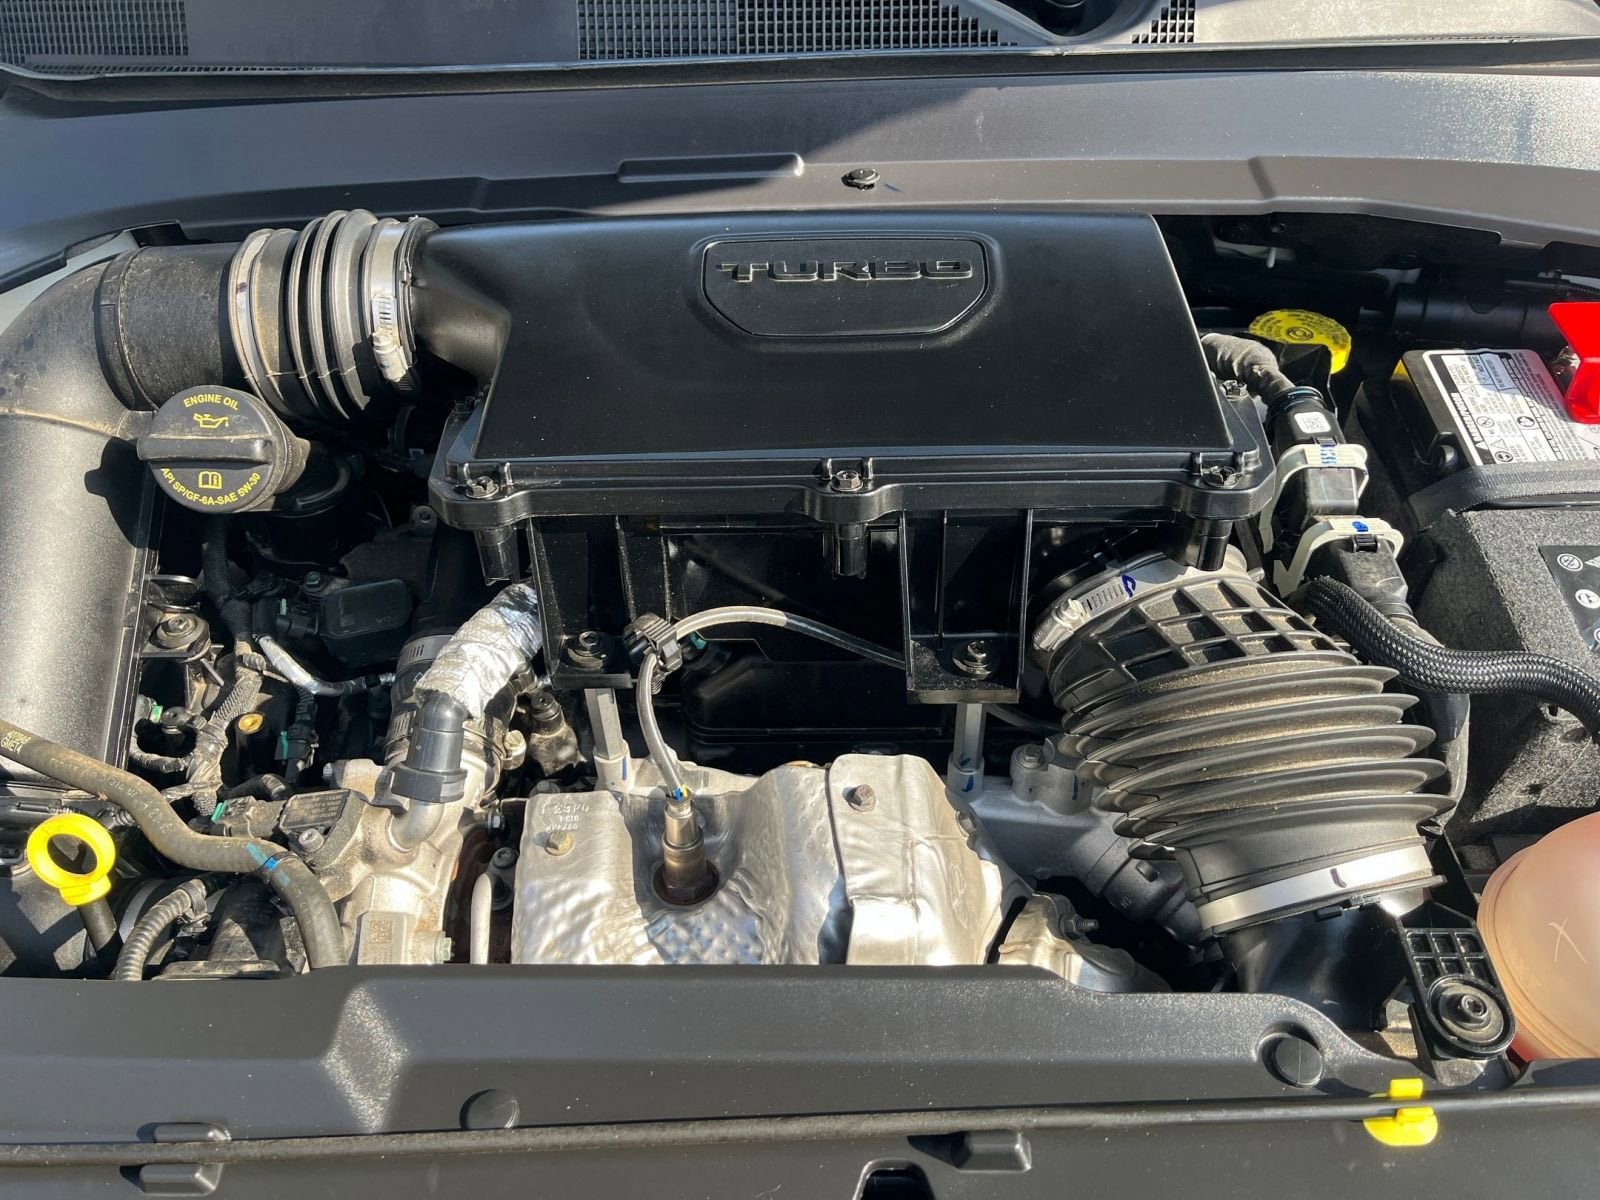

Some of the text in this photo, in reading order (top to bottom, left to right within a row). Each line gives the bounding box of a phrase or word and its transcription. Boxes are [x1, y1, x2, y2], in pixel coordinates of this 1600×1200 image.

[719, 258, 973, 283] TURBO
[183, 393, 239, 411] ENGINE OIL
[160, 468, 261, 506] API SP/GF-6A-SAE 5W-30
